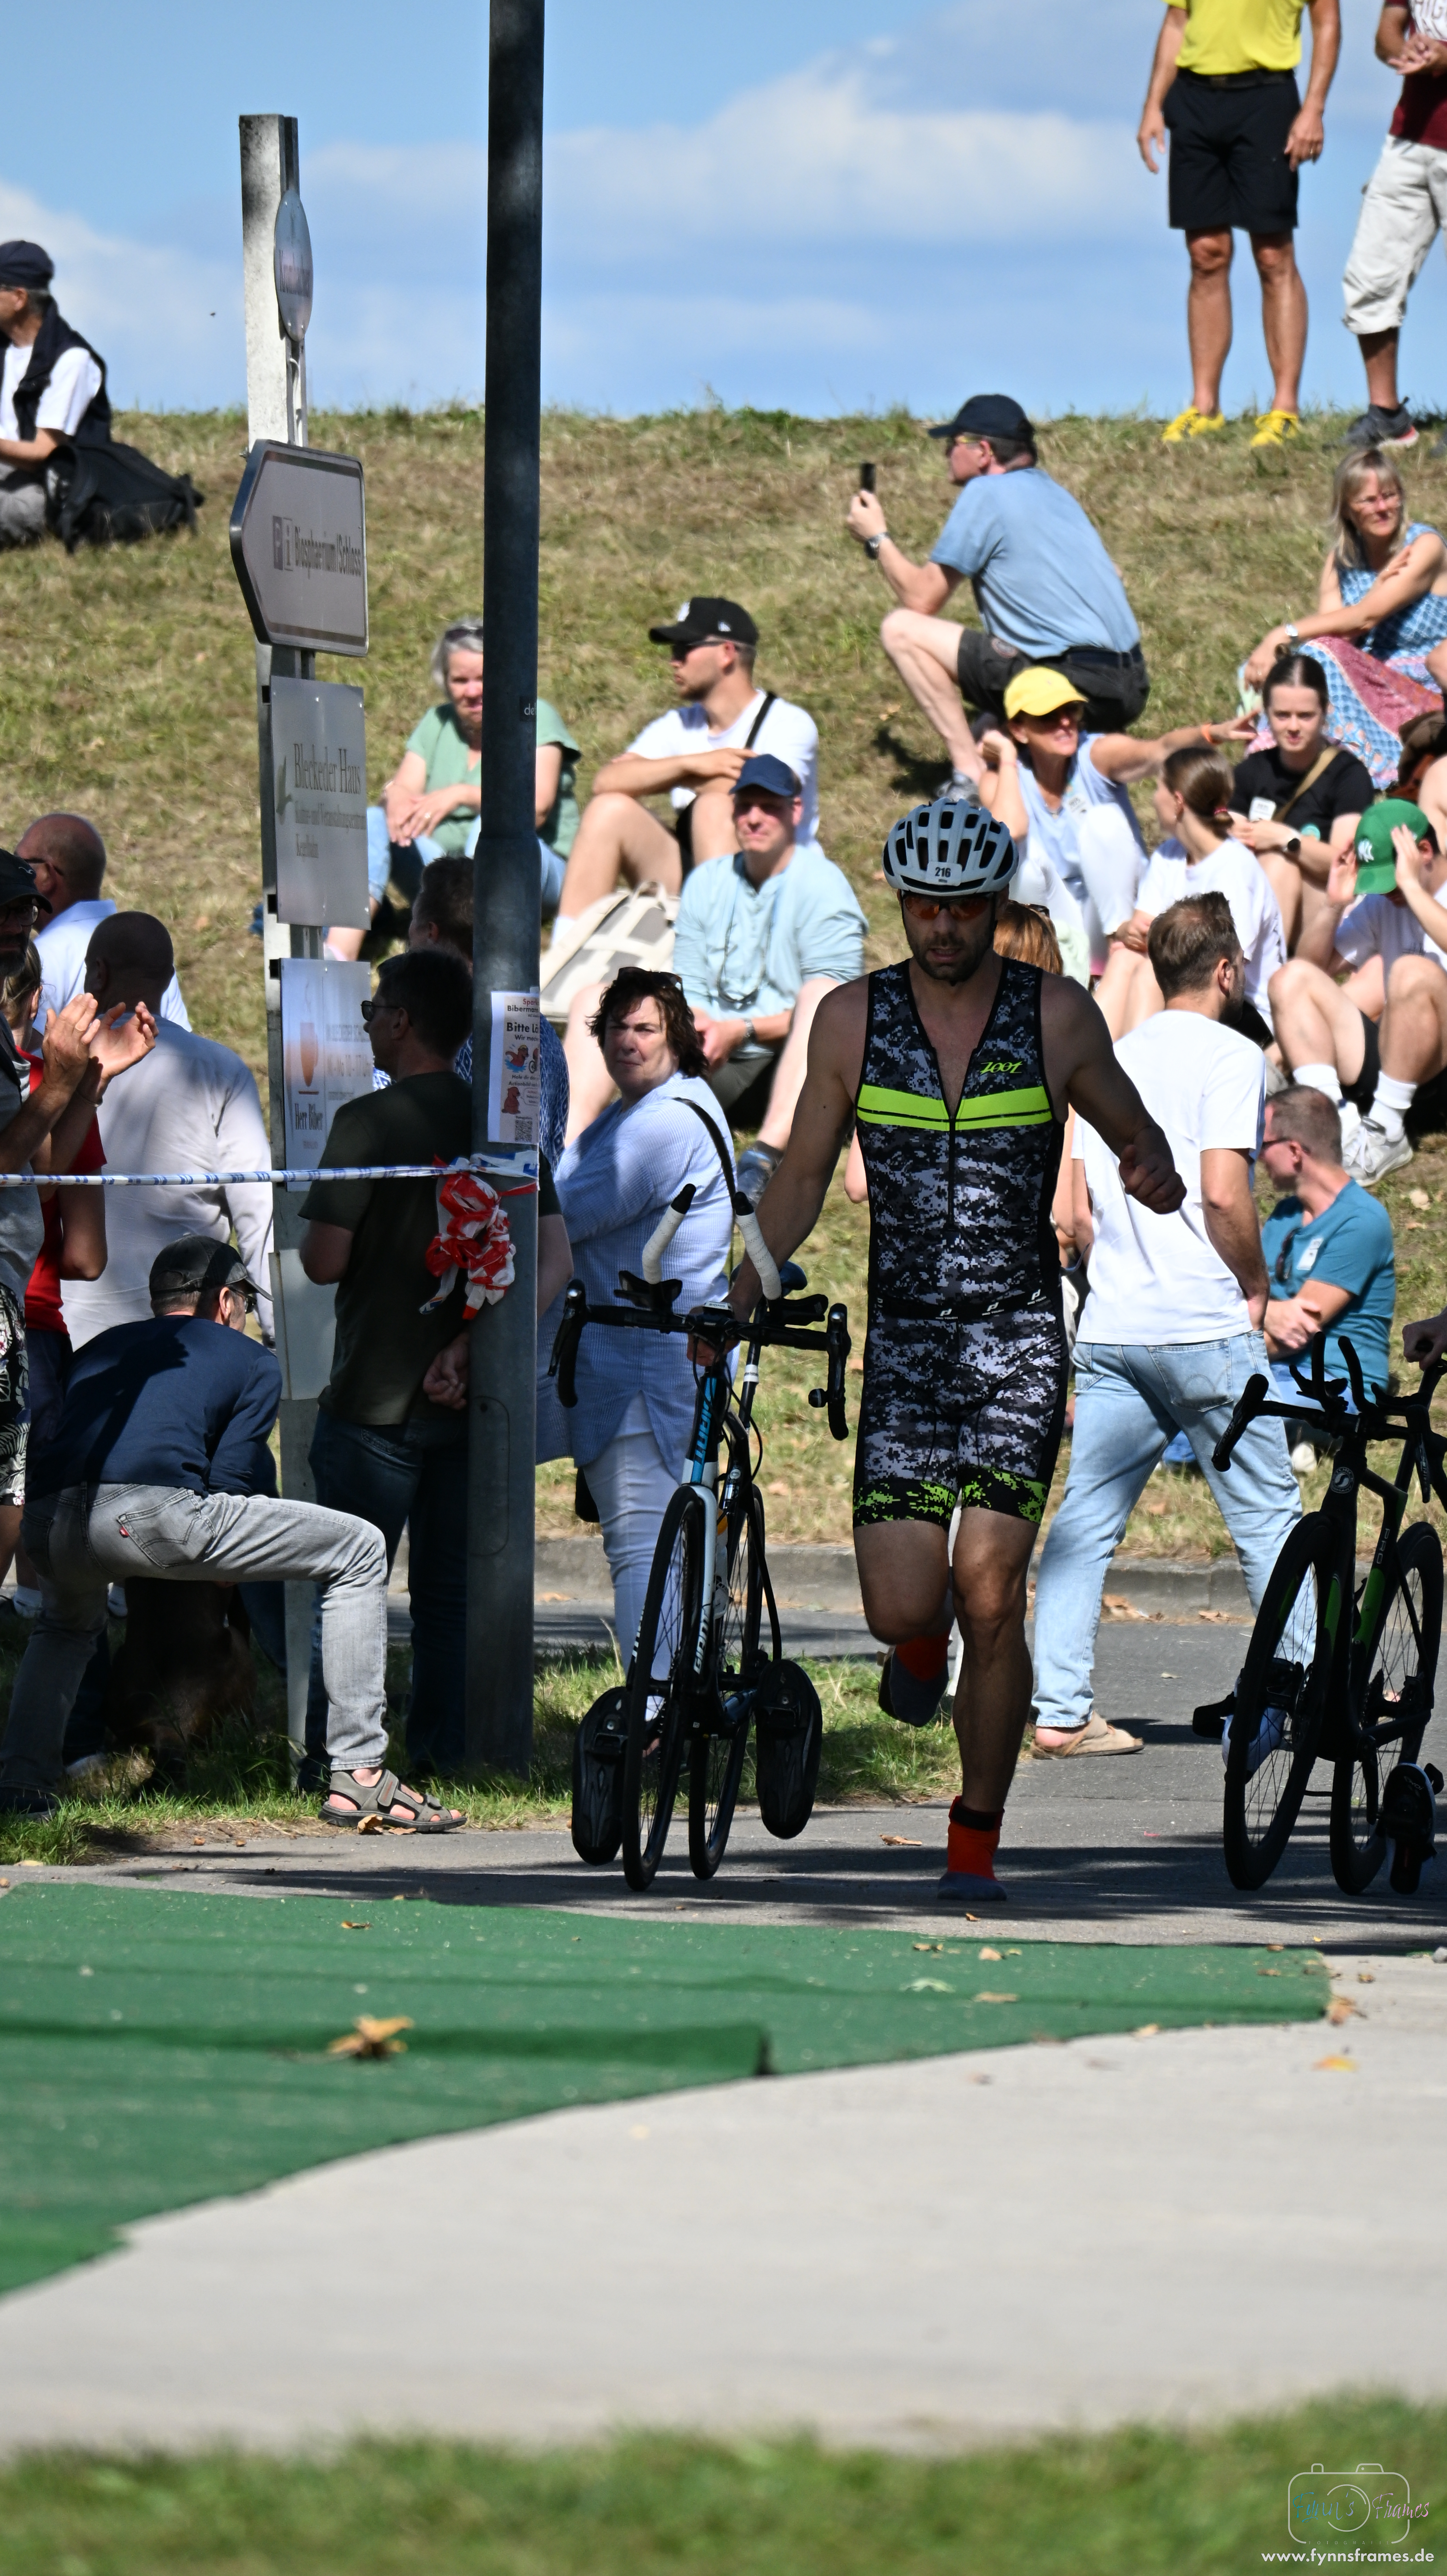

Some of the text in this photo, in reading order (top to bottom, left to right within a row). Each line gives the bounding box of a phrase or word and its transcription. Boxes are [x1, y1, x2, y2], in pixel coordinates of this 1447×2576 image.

[294, 743, 361, 794] Bleckeder Haus
[934, 867, 951, 878] 216
[507, 1022, 530, 1033] Bitte
[295, 1103, 307, 1130] Herr
[1376, 1528, 1391, 1564] PRO
[694, 1617, 710, 1675] GIANT
